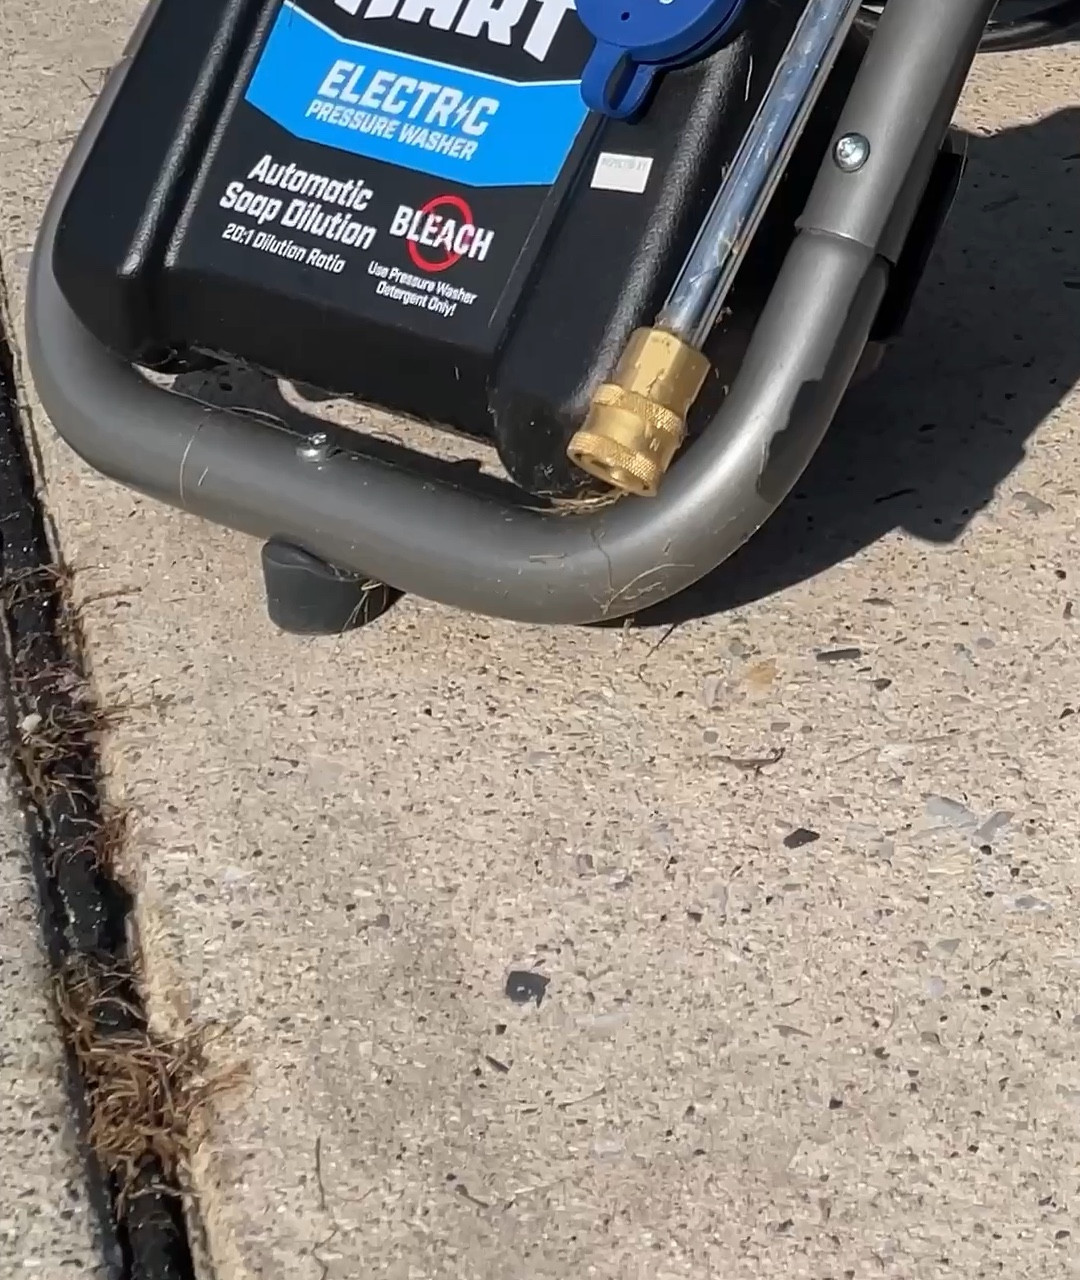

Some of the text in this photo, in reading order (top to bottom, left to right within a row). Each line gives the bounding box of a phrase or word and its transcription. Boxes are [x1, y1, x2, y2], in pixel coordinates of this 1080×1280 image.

[317, 59, 500, 136] ELECTRIC
[305, 99, 479, 161] PRESSURE WASHER
[247, 154, 373, 211] Automatic
[219, 181, 378, 250] Soap Dilution
[389, 204, 495, 261] BLEACH
[221, 222, 347, 273] 20:1 Dilution Ratio
[367, 260, 478, 305] Use Pressure Washer
[375, 280, 458, 317] Detergent Only!
